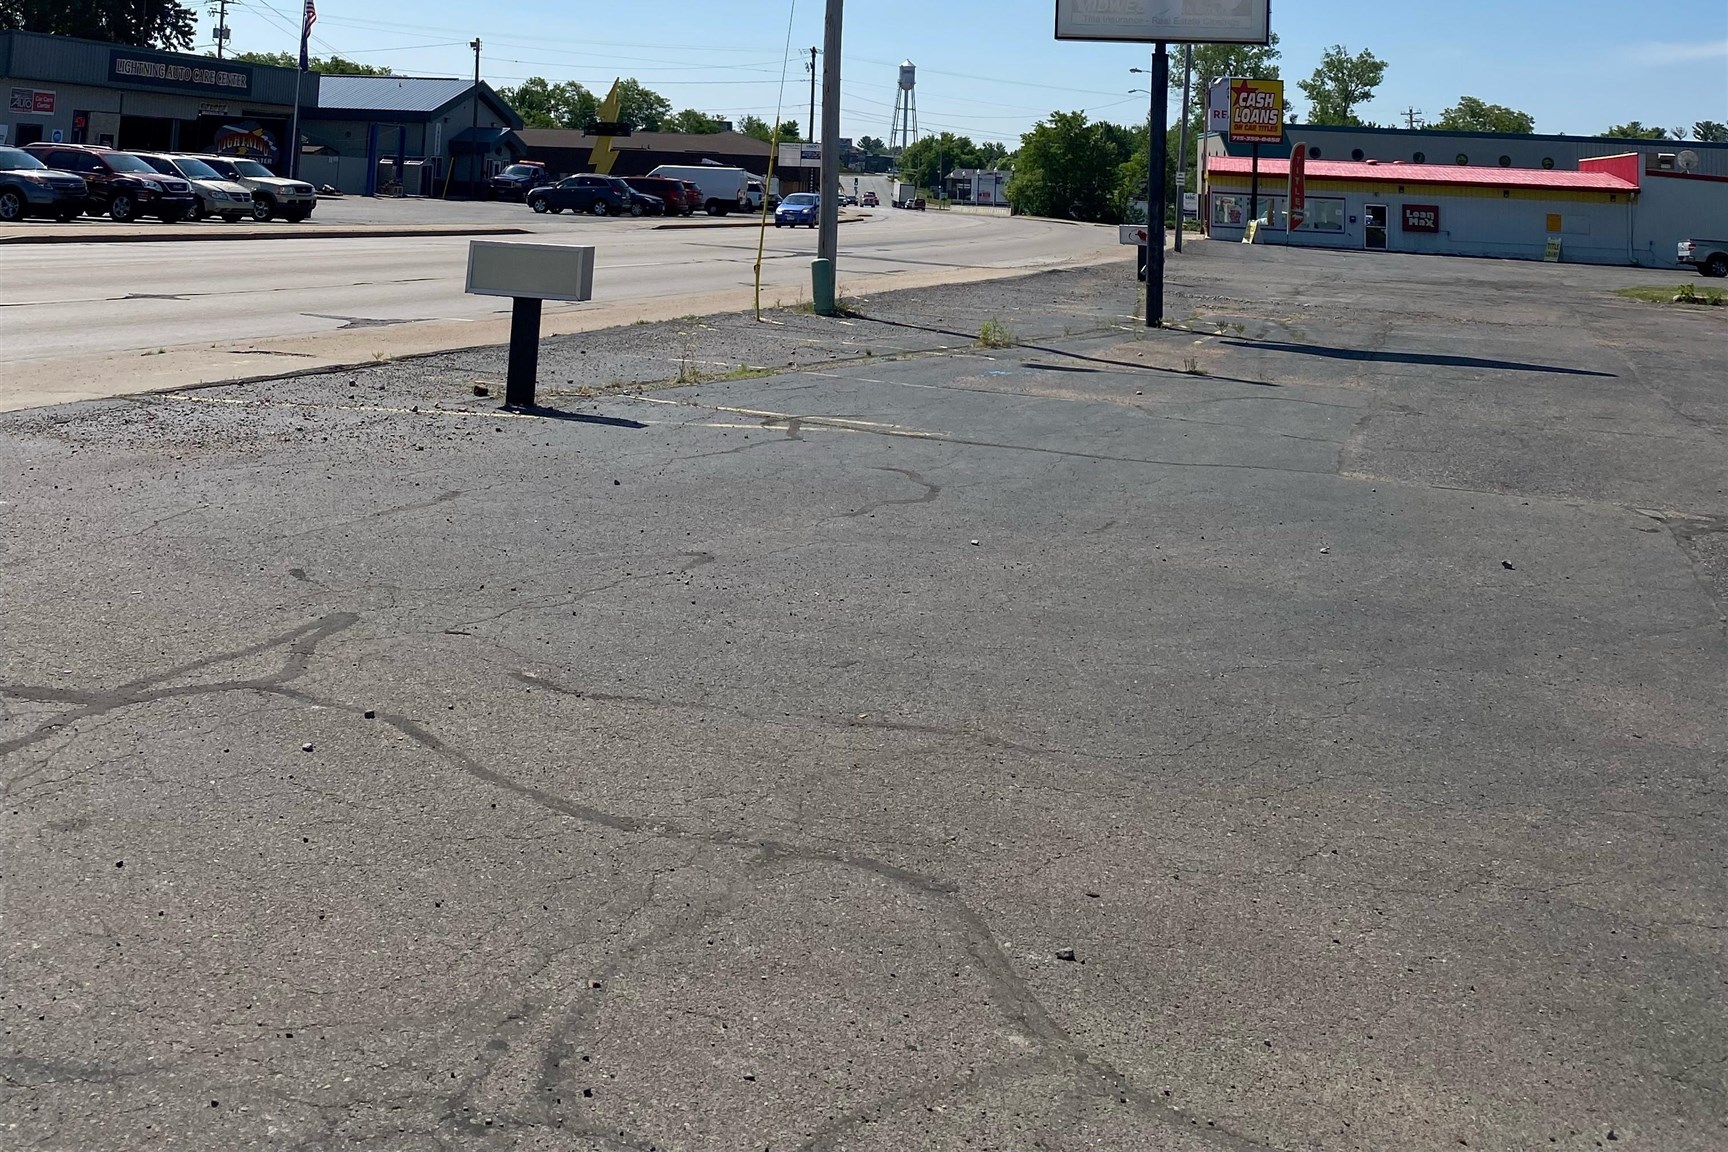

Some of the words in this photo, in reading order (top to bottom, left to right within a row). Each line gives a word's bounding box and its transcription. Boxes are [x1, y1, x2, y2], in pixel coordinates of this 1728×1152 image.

[115, 58, 166, 79] LIGHTNING
[166, 64, 191, 82] AUTO
[192, 68, 216, 84] CARE
[216, 71, 247, 88] CENTER
[1239, 92, 1275, 108] CASH
[1234, 108, 1279, 124] LOANS
[1406, 209, 1435, 220] Loan
